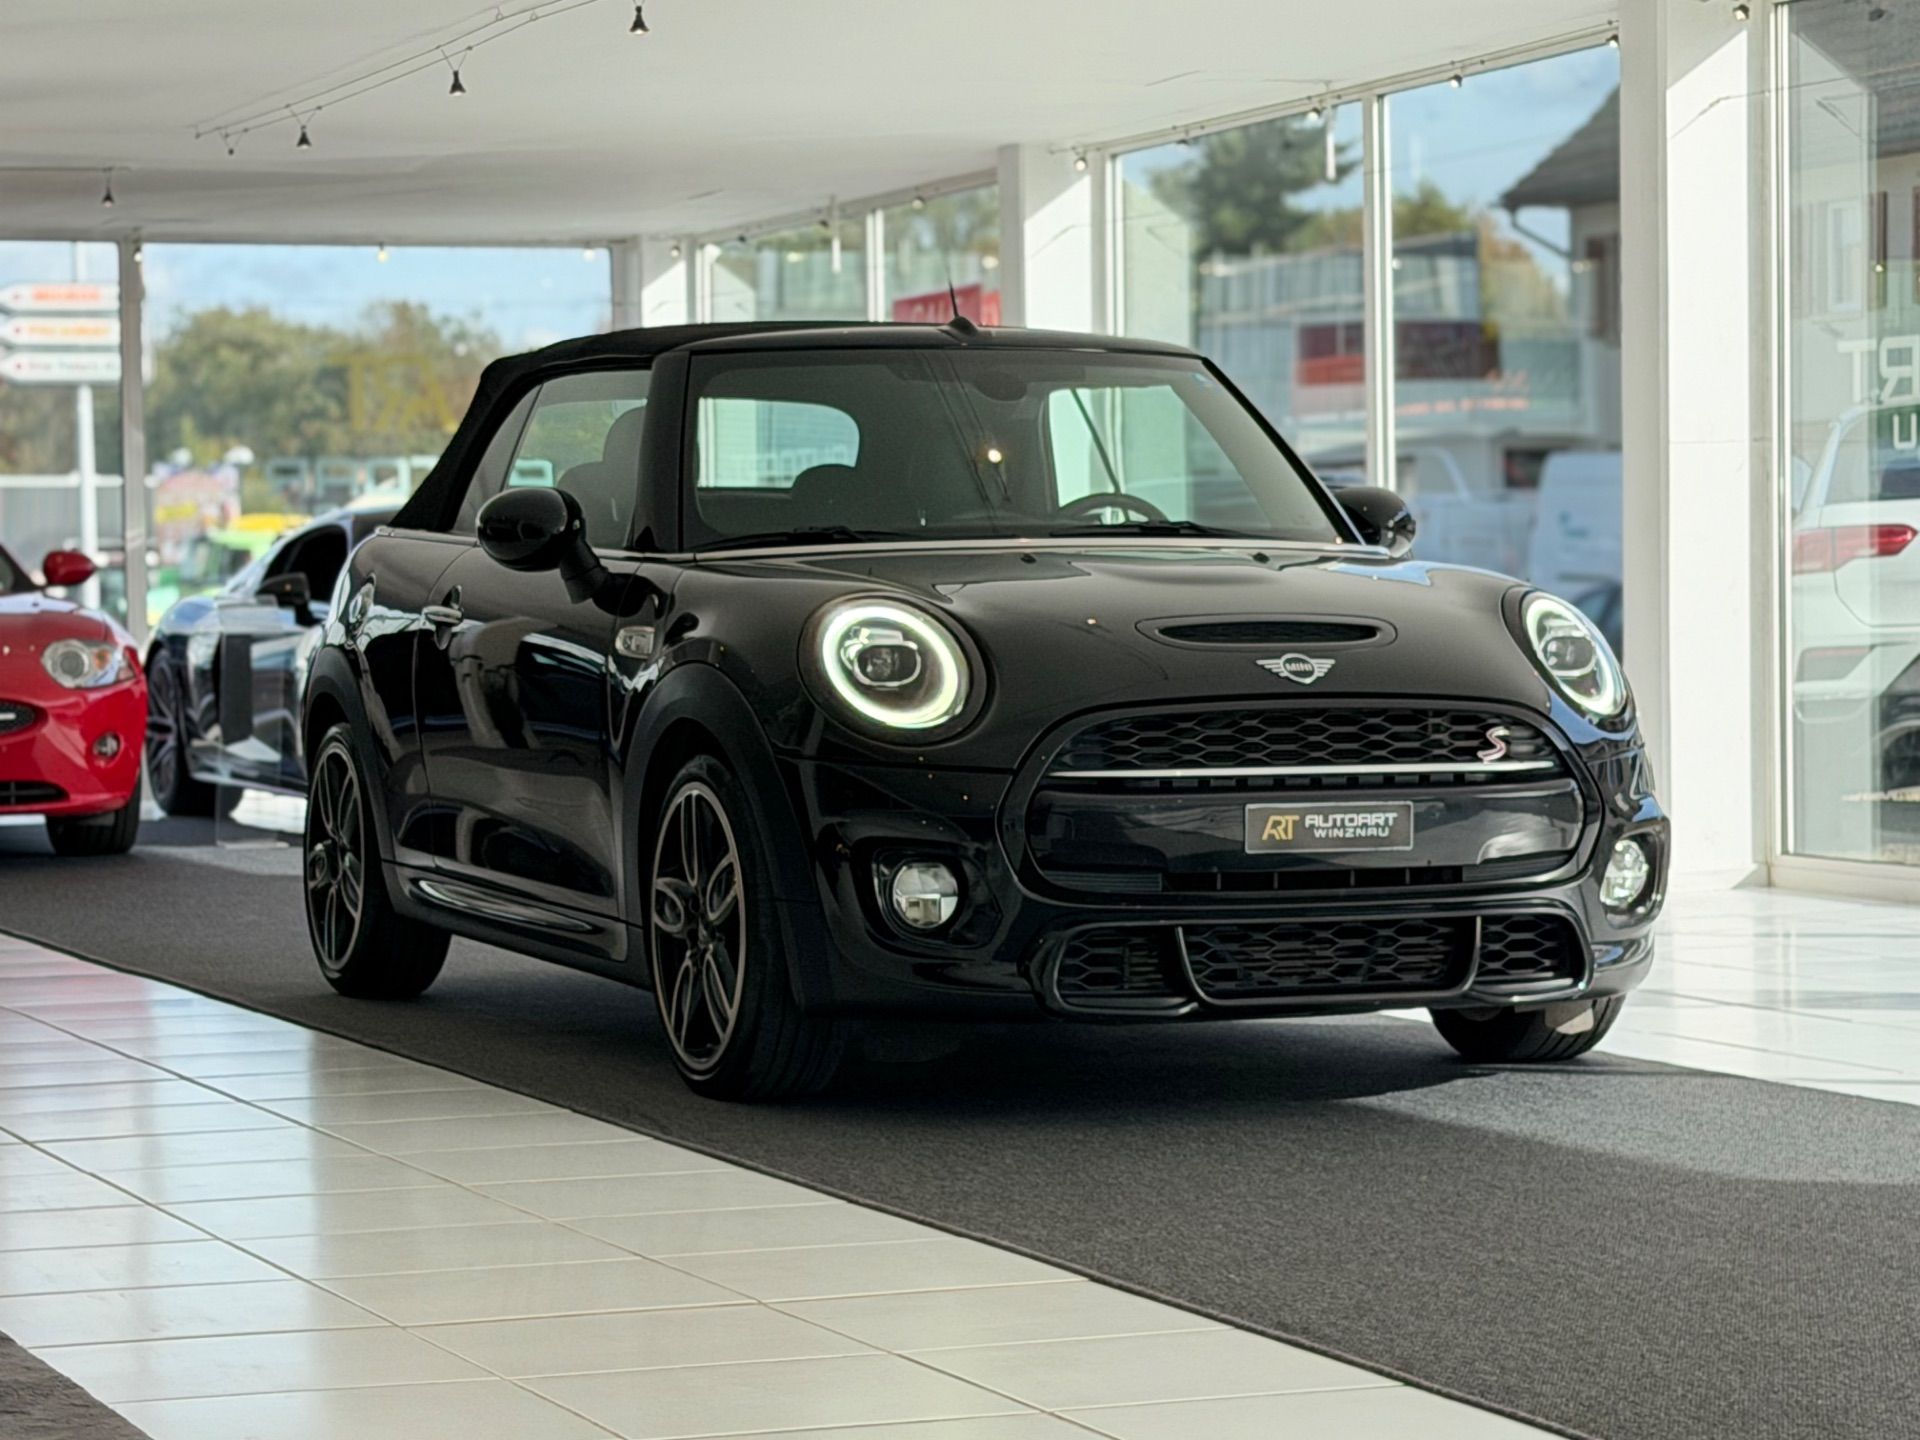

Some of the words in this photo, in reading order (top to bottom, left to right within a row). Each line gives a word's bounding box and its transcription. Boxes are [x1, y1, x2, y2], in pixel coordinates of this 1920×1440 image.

[1476, 725, 1510, 762] S
[1304, 812, 1398, 829] AUTOART
[1313, 827, 1390, 839] WINZNAU
